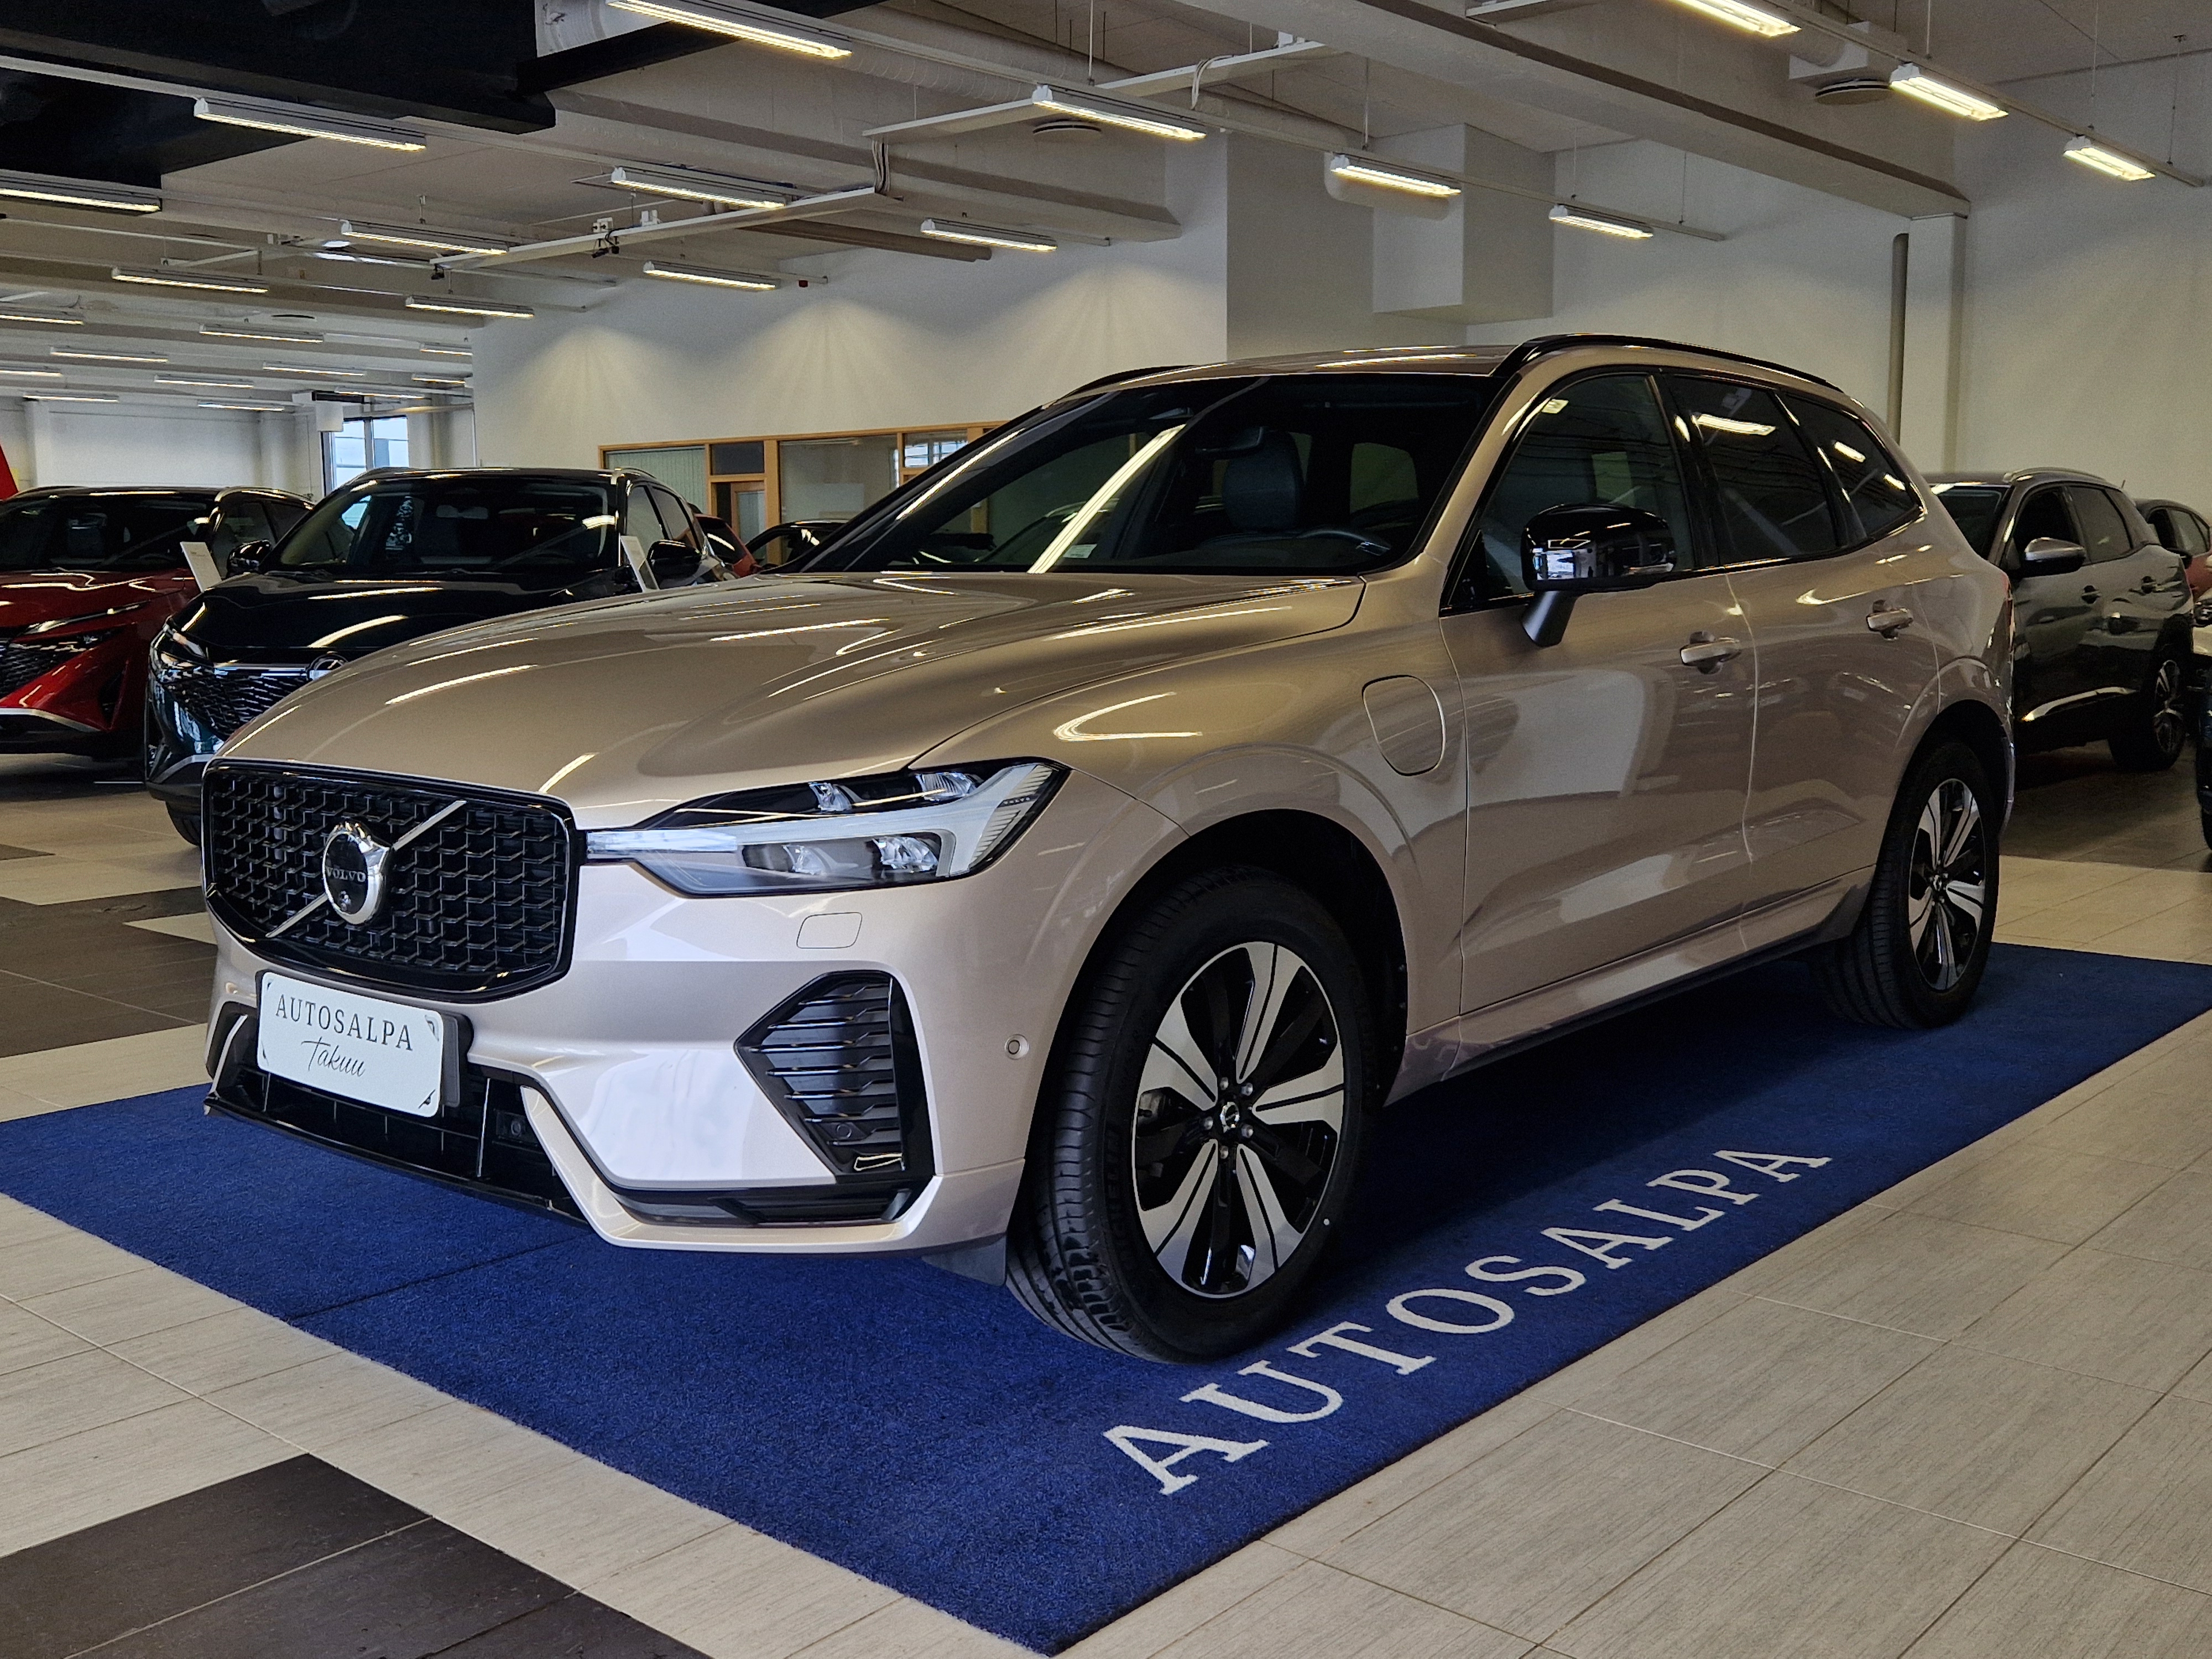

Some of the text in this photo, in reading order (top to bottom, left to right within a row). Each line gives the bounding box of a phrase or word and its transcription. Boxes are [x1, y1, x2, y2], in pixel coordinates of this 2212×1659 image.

[325, 865, 366, 883] VOLVO
[276, 994, 413, 1051] AUTOSALPA
[301, 1036, 366, 1077] Takuu
[1102, 1149, 1832, 1496] AUTOSALPA
